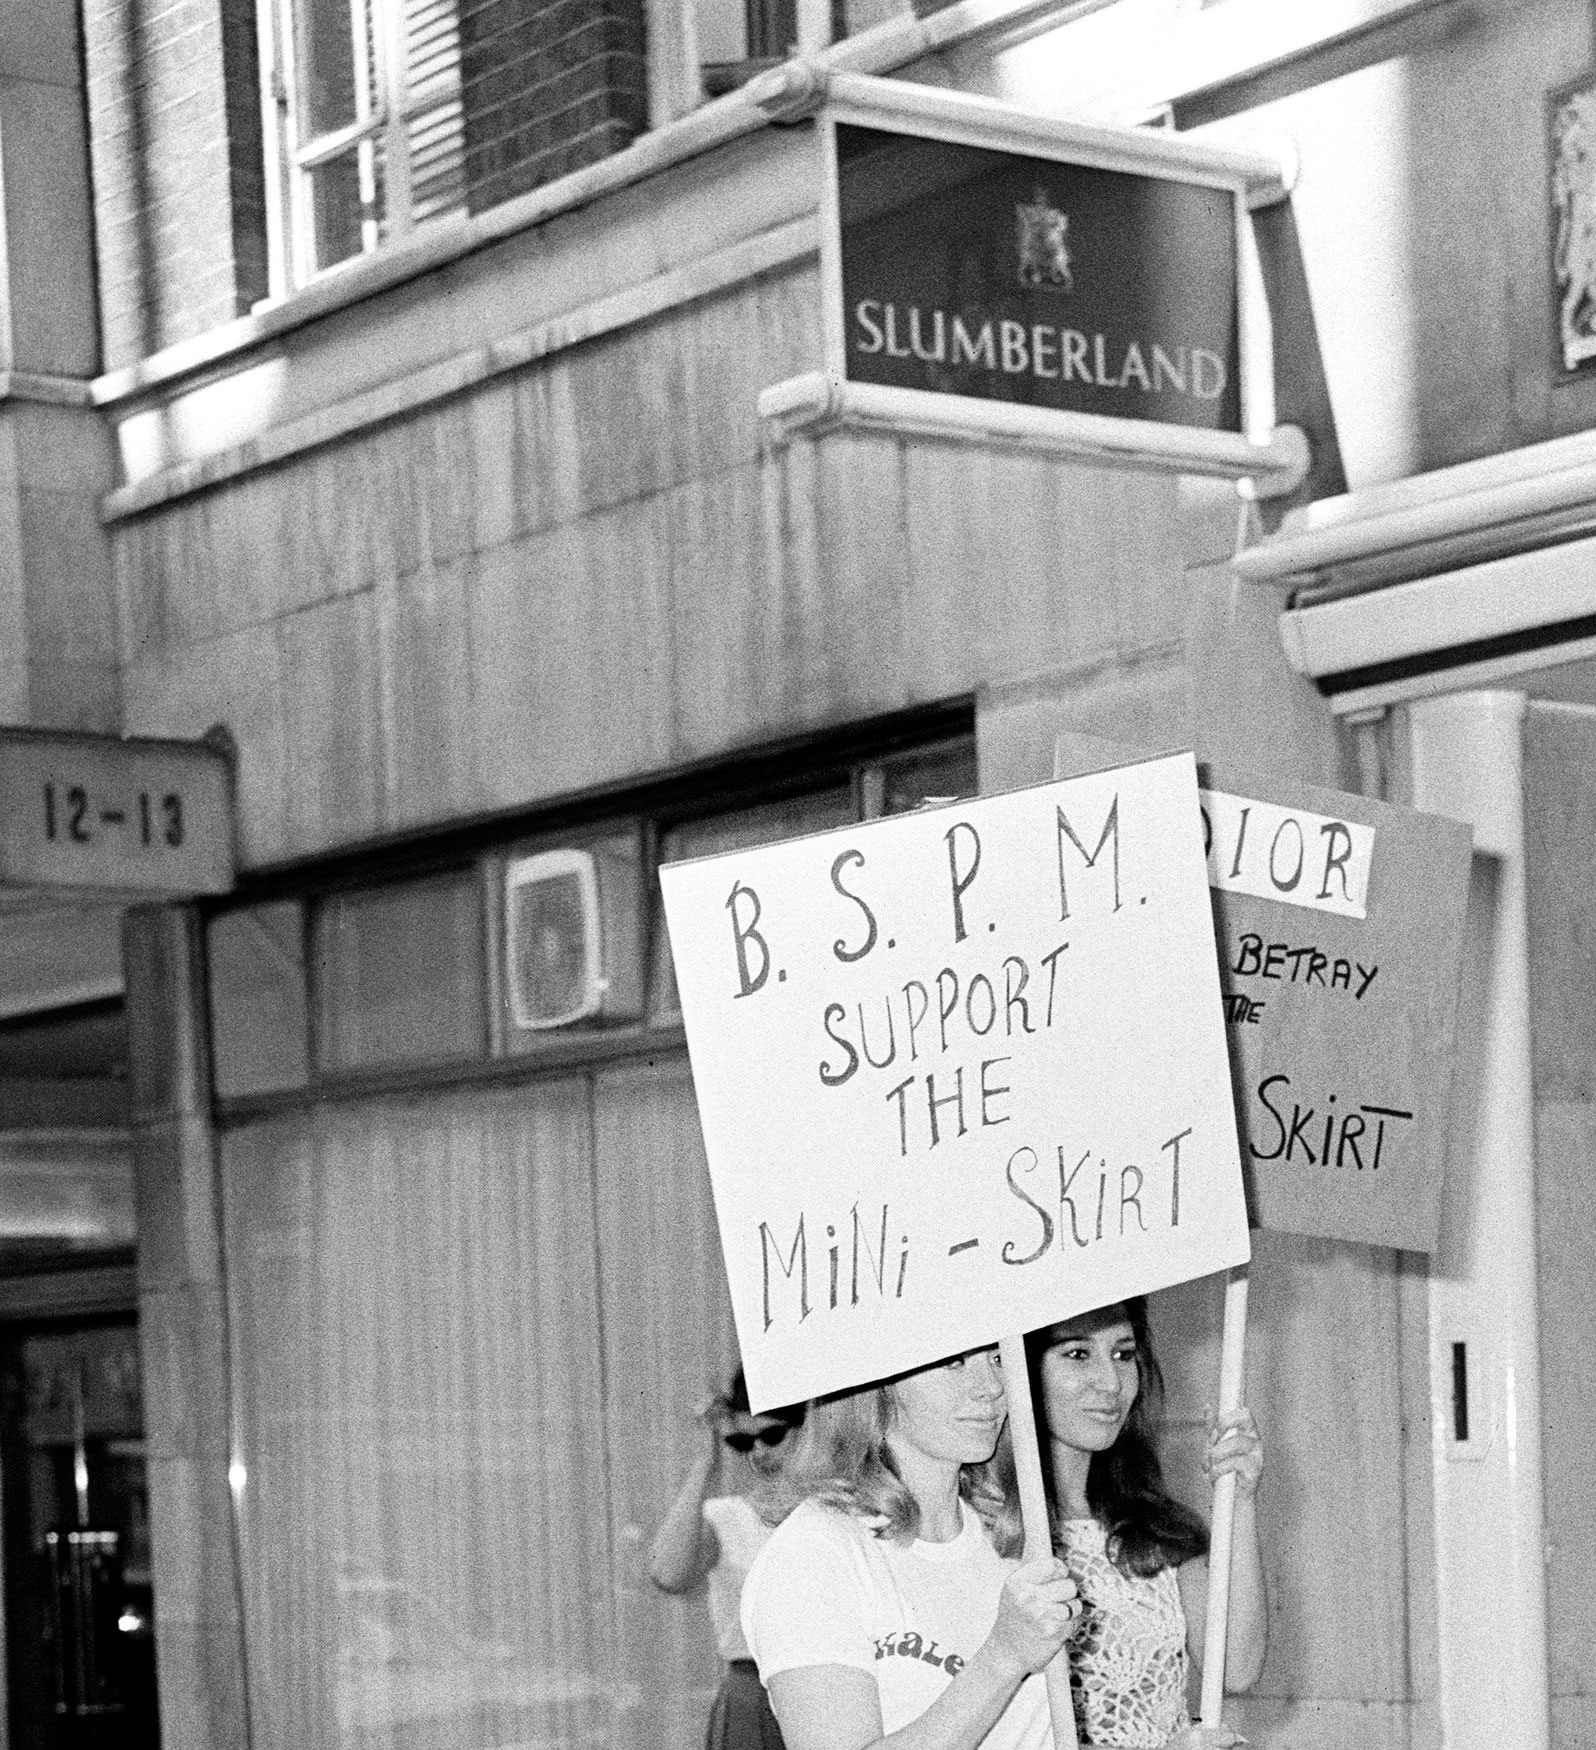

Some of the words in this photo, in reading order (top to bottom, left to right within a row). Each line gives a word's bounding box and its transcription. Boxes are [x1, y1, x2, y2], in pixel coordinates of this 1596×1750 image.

[855, 299, 1229, 401] SLUMBERLAND
[818, 943, 1070, 1087] SUPPORT
[1232, 933, 1379, 1000] BETRAY
[886, 1056, 1013, 1156] THE
